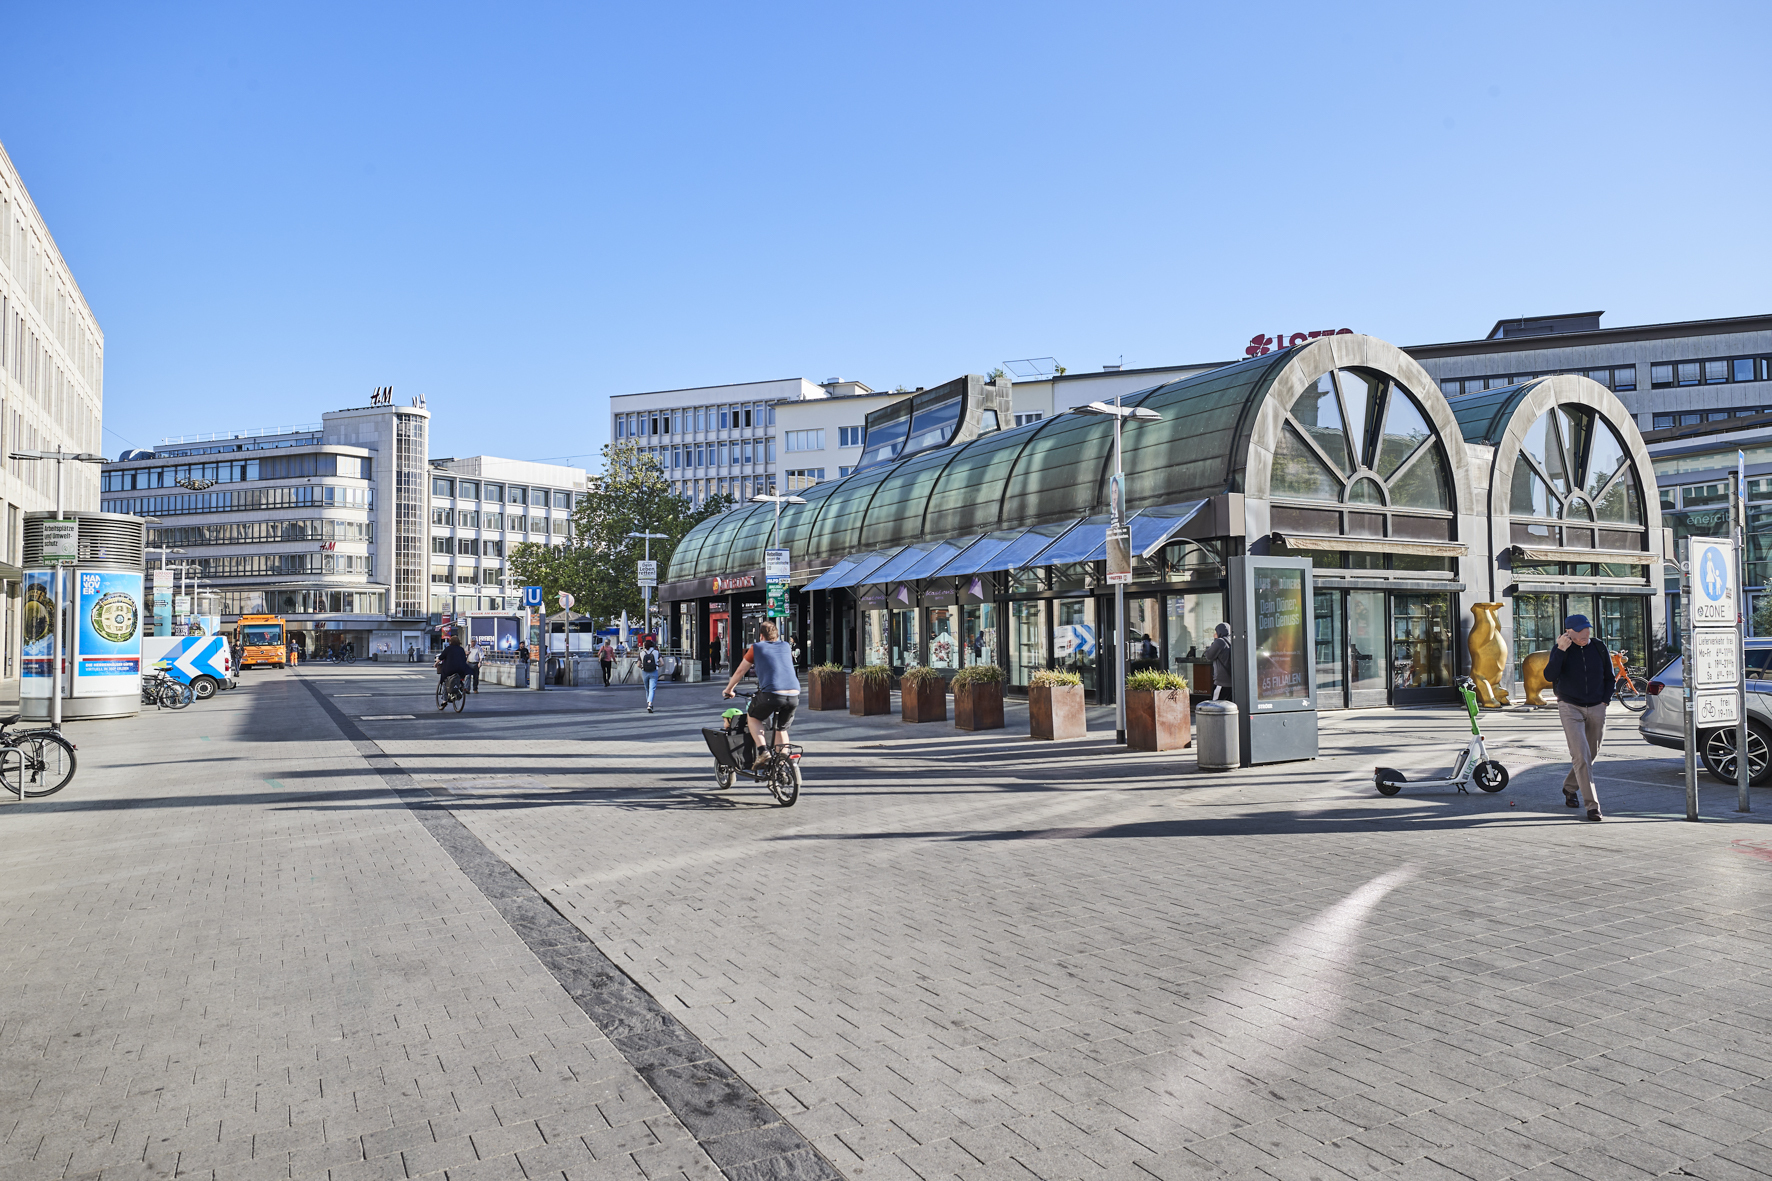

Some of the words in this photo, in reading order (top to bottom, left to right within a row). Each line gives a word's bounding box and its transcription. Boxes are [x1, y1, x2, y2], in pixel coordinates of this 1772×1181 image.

[1686, 510, 1732, 526] enercit
[528, 588, 541, 604] U
[1260, 599, 1276, 614] Dein
[1276, 597, 1298, 612] Döner,
[1704, 604, 1726, 618] ZONE
[1259, 613, 1275, 630] Dein
[1275, 612, 1300, 628] Genuss
[1262, 677, 1272, 690] 65
[1272, 672, 1302, 688] FILIALEN
[1720, 697, 1731, 707] frei
